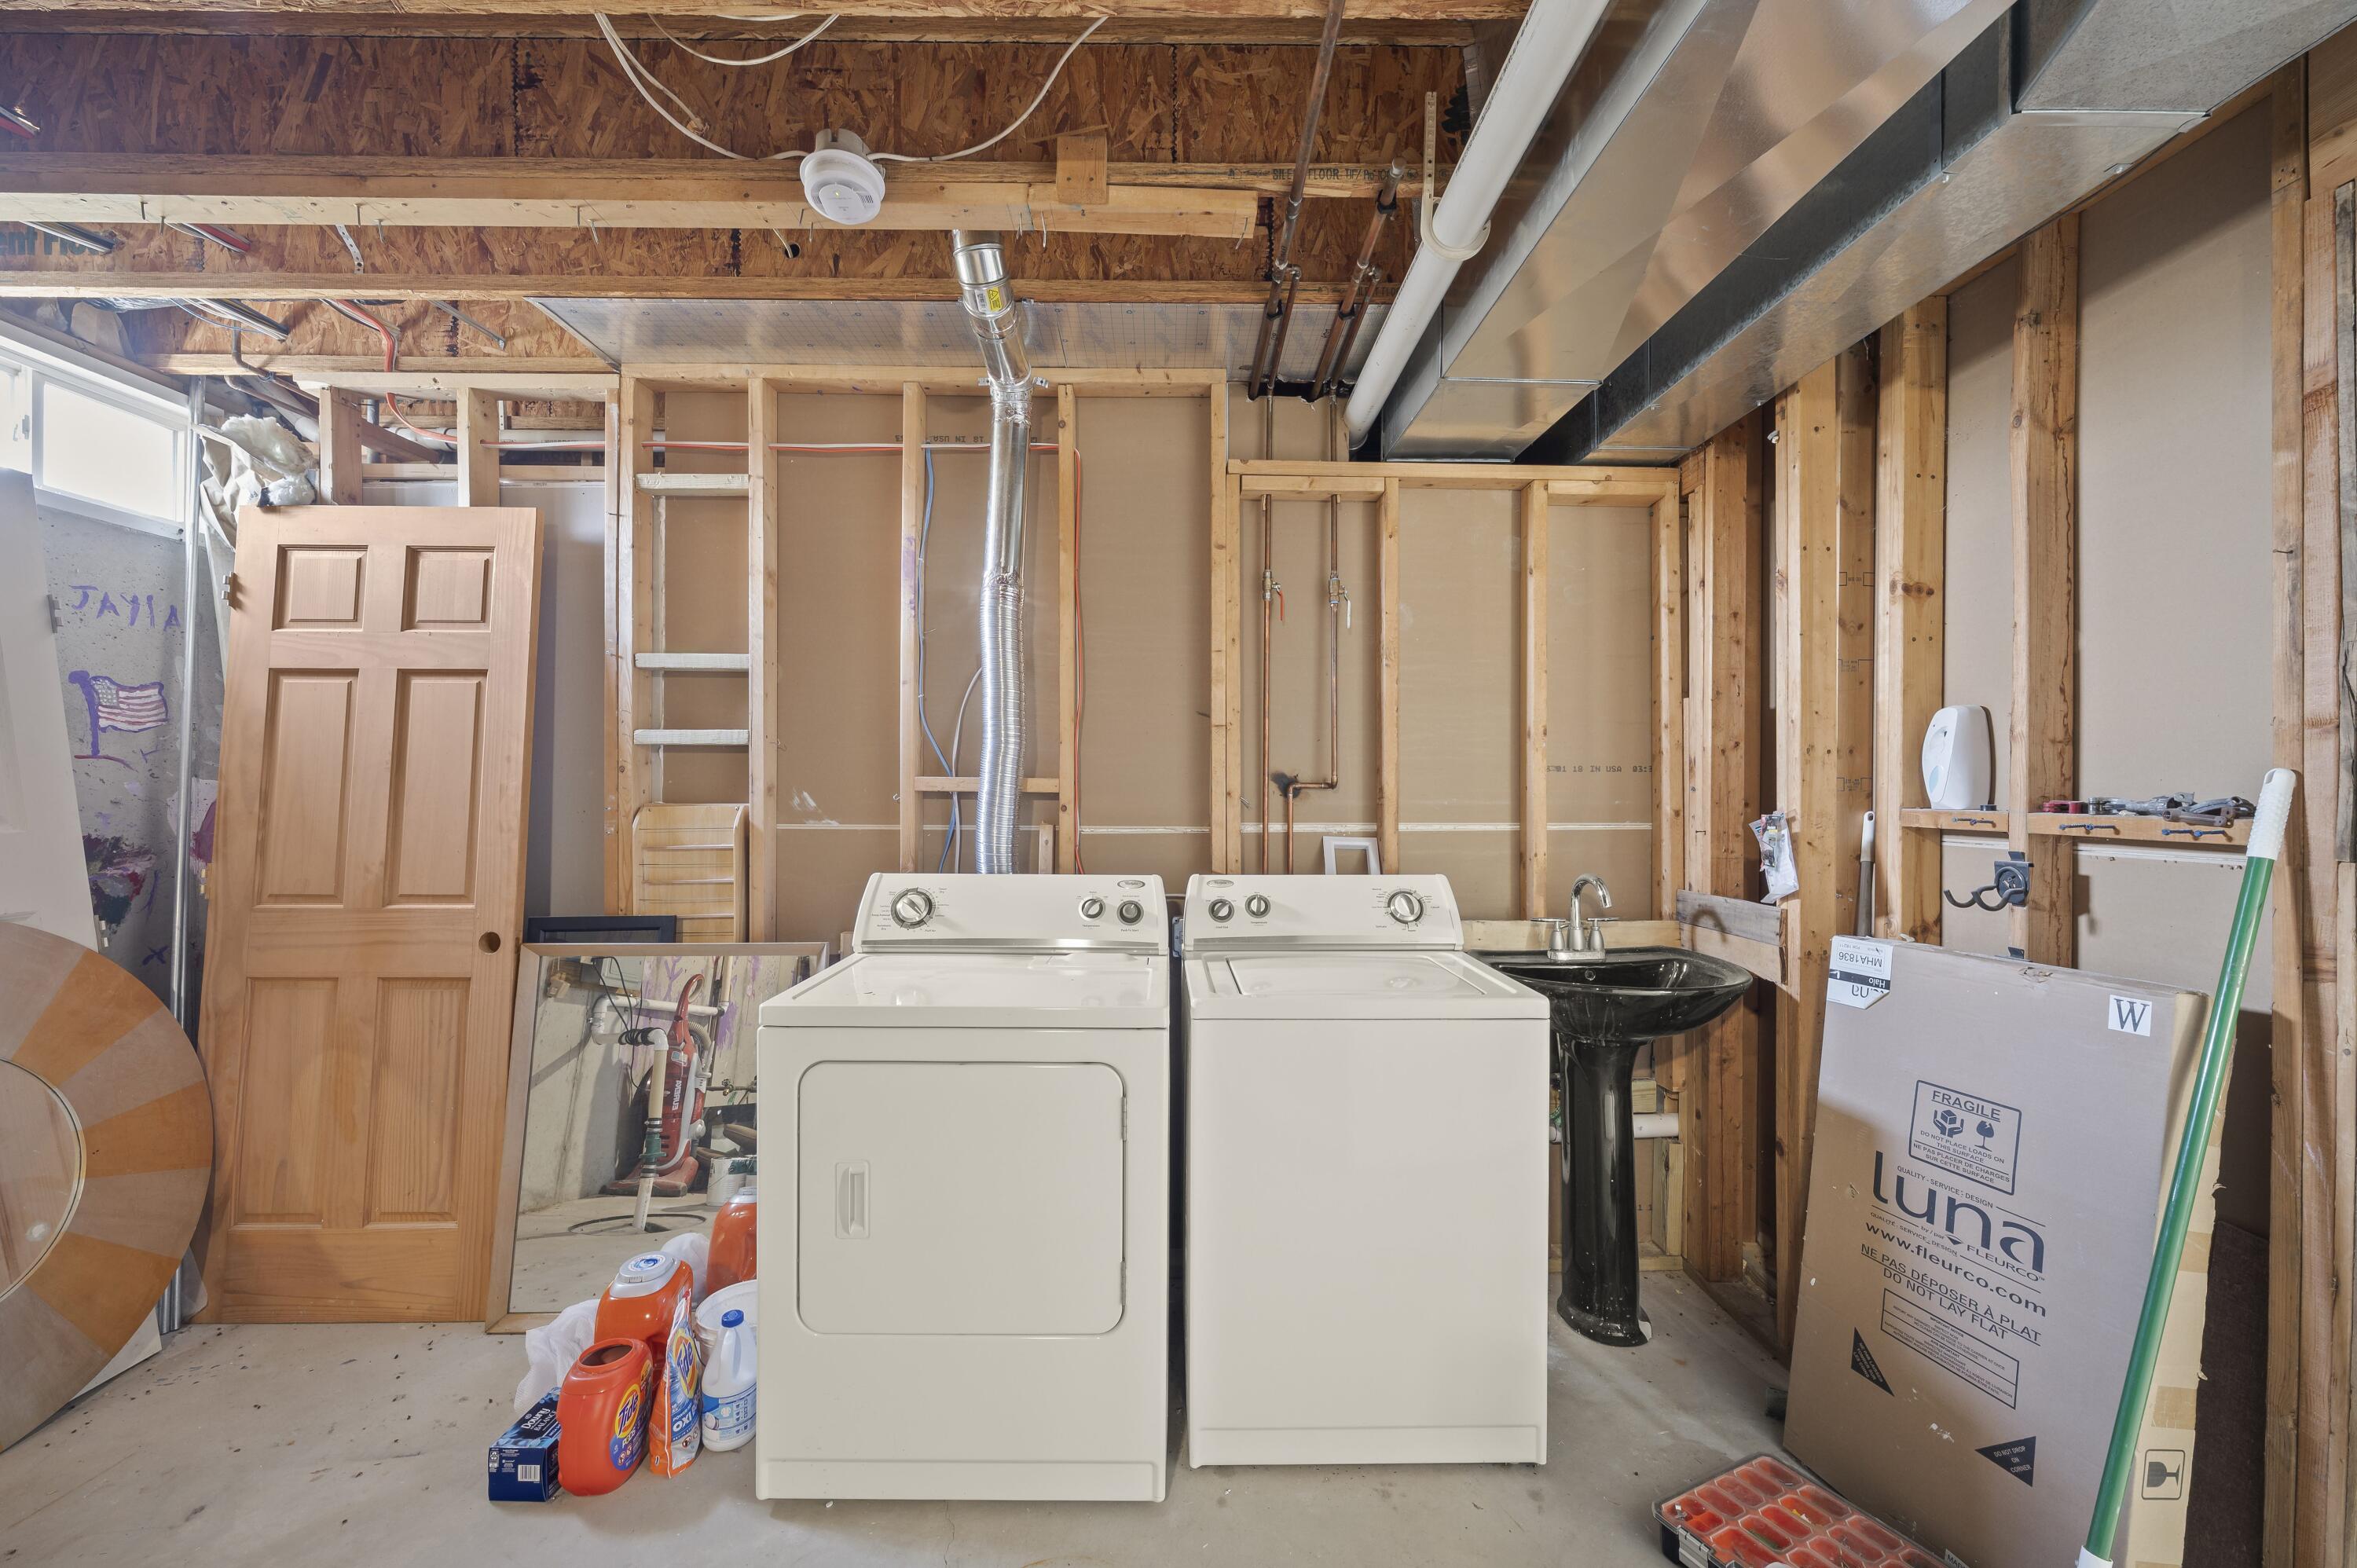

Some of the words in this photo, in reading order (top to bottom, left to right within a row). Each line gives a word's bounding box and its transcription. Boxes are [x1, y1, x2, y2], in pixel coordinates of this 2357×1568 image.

[1308, 168, 1340, 180] FLOOR
[1838, 951, 1882, 968] MHA1836
[1868, 977, 1886, 988] Halo
[2113, 998, 2150, 1032] W
[1933, 1090, 2001, 1120] FRAGILE
[1923, 1145, 1936, 1156] PAS
[1937, 1151, 1963, 1165] PLACER
[1975, 1165, 2010, 1182] CHARGES
[1930, 1132, 1944, 1141] NOT
[1945, 1136, 1967, 1151] PLACE
[1968, 1145, 1992, 1160] LOADS
[1994, 1156, 2005, 1164] ON
[1937, 1142, 1952, 1152] THIS
[1952, 1147, 1985, 1163] SURFACE
[1925, 1153, 1939, 1163] SUR
[1940, 1158, 1961, 1171] CETTE
[1962, 1167, 1996, 1184] SURFACE
[1897, 1165, 1926, 1181] QUALITY
[1930, 1178, 1960, 1196] SERVICE
[1965, 1192, 1993, 1208] DESIGN
[1873, 1150, 2044, 1273] luna
[1900, 1225, 1926, 1241] SERVICE
[1932, 1240, 1958, 1257] DESIGN
[1866, 1222, 2046, 1317] www.fleurco.com
[1861, 1244, 1877, 1257] NE
[1882, 1254, 1907, 1273] PAS
[1911, 1267, 1978, 1311] DÉPOSER
[1984, 1304, 1994, 1320] À
[2000, 1314, 2041, 1343] PLAT
[1883, 1267, 1902, 1284] DO
[1906, 1280, 1935, 1301] NOT
[1940, 1297, 1967, 1317] LAY
[1971, 1313, 2009, 1339] FLAT
[676, 1340, 694, 1395] Tide
[521, 1408, 551, 1429] Downy
[618, 1394, 639, 1438] Tide
[673, 1411, 692, 1431] OXI
[2002, 1448, 2012, 1456] NOT
[2011, 1464, 2032, 1473] CORNER
